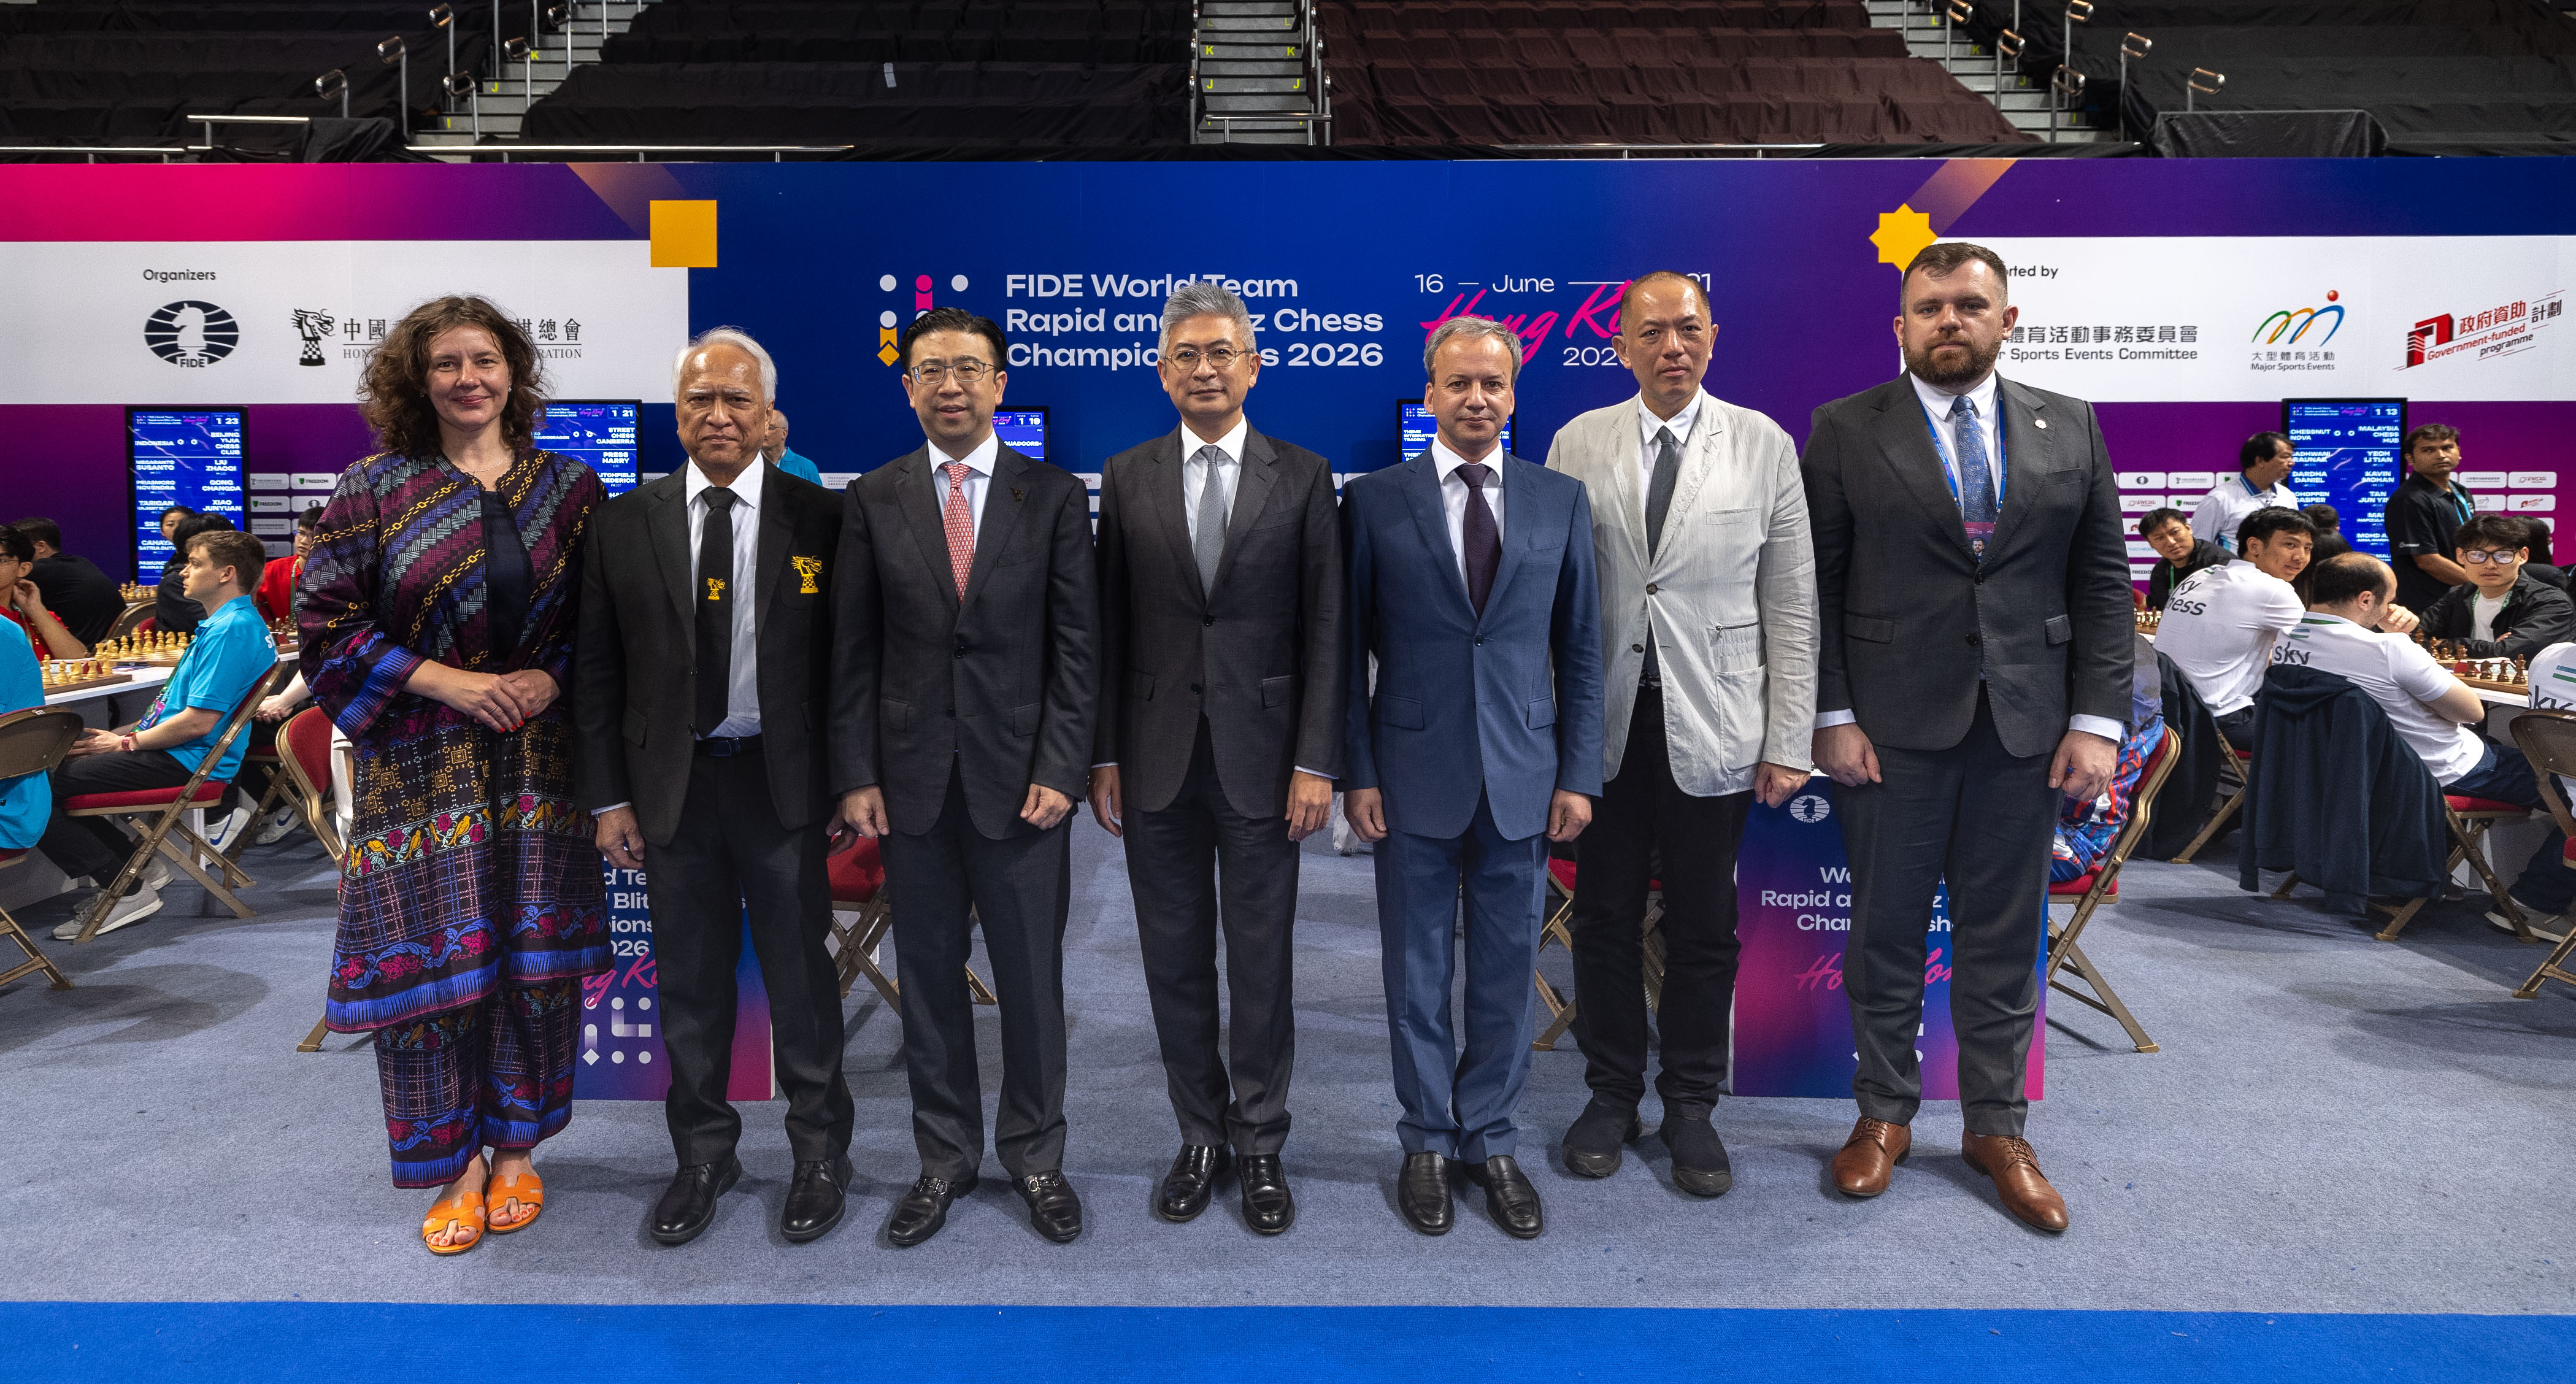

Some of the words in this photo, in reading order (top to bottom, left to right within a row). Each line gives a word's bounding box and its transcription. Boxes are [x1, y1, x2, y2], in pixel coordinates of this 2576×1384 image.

[1207, 18, 1213, 26] L
[531, 51, 539, 60] K
[1205, 45, 1214, 55] K
[1287, 47, 1295, 56] K
[491, 82, 498, 92] J
[1207, 79, 1213, 88] J
[1293, 79, 1300, 88] J
[143, 269, 216, 283] Organizers
[2041, 265, 2059, 279] by
[1007, 274, 1083, 297] FIDE
[1415, 274, 1444, 293] 16
[1493, 275, 1555, 293] June
[1007, 307, 1105, 336] Rapid
[1113, 313, 1164, 332] an
[1274, 309, 1383, 332] Chess
[2458, 300, 2527, 335] 政府資助
[2531, 301, 2563, 323] 計劃
[2006, 326, 2199, 344] 體育活動事務委員會
[2427, 323, 2526, 361] Government-funded
[343, 348, 371, 359] HON
[2480, 333, 2534, 358] programme
[180, 358, 205, 368] FIDE
[1288, 343, 1383, 367] 2026
[1563, 347, 1621, 366] 202
[2010, 348, 2060, 363] Sports
[2065, 348, 2114, 360] Events
[2118, 347, 2199, 360] Committee
[2251, 351, 2336, 361] 大型體育活動
[2251, 363, 2276, 372] Major
[2277, 363, 2306, 372] Sports
[2178, 575, 2202, 596] ky
[2167, 596, 2207, 615] hess
[621, 869, 647, 885] Te
[613, 891, 650, 909] Blit
[1761, 890, 1831, 910] Rapid
[613, 940, 650, 956] 26
[1794, 952, 1844, 991] Ho
